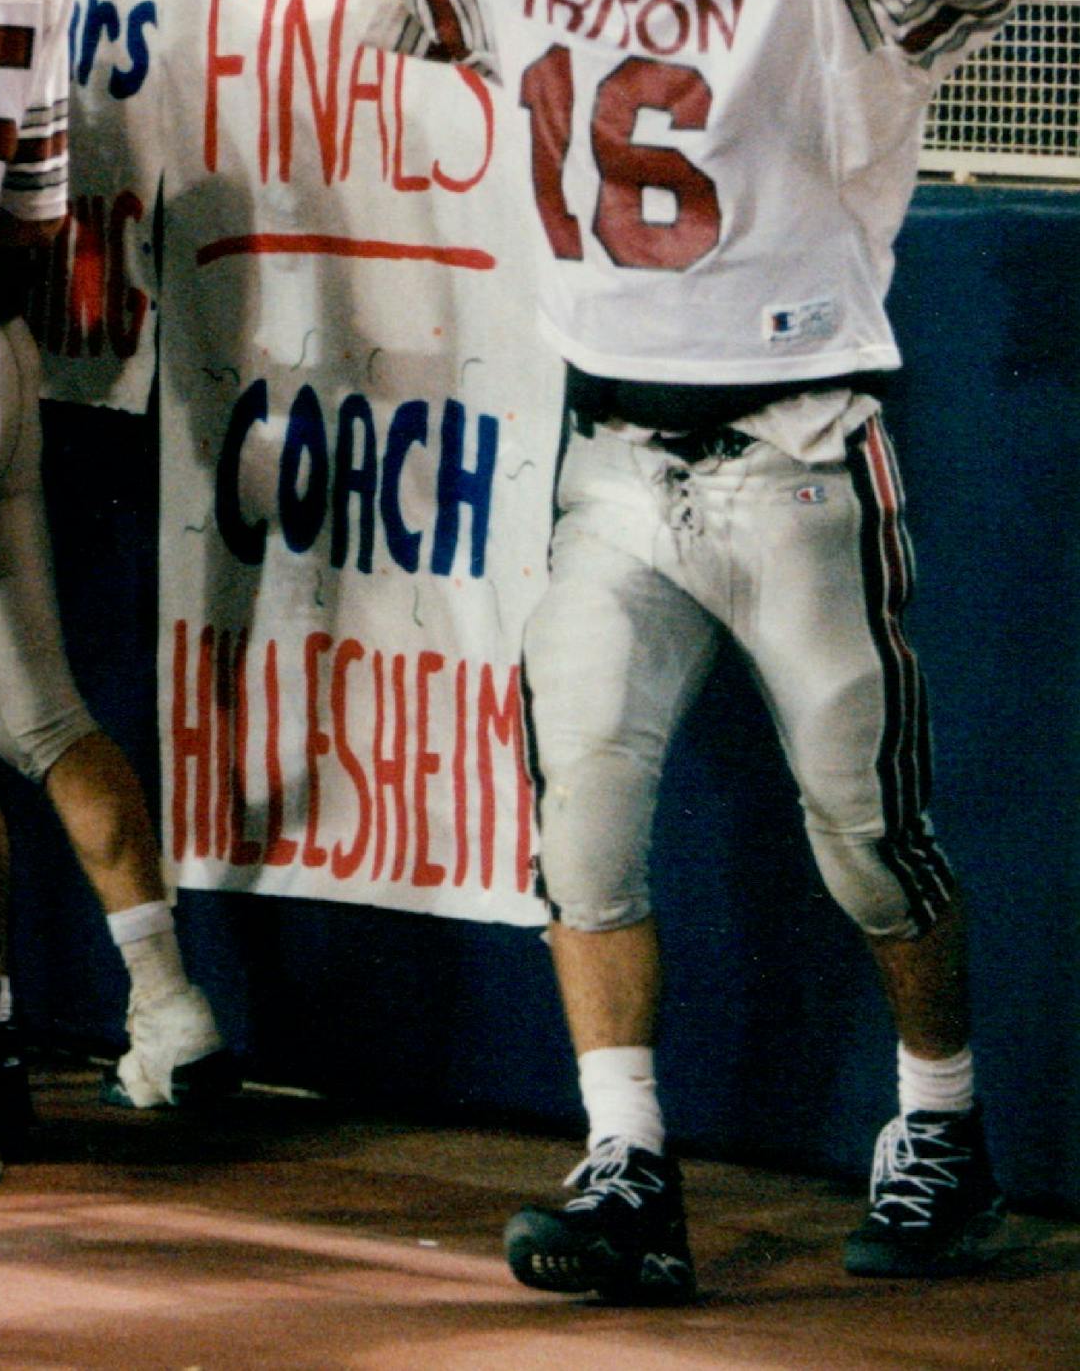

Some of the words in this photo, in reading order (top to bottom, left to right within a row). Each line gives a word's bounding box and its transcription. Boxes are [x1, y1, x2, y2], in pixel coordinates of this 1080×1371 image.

[519, 42, 722, 273] 16
[215, 378, 499, 579] COACH
[170, 619, 533, 894] HILLESHEIM
